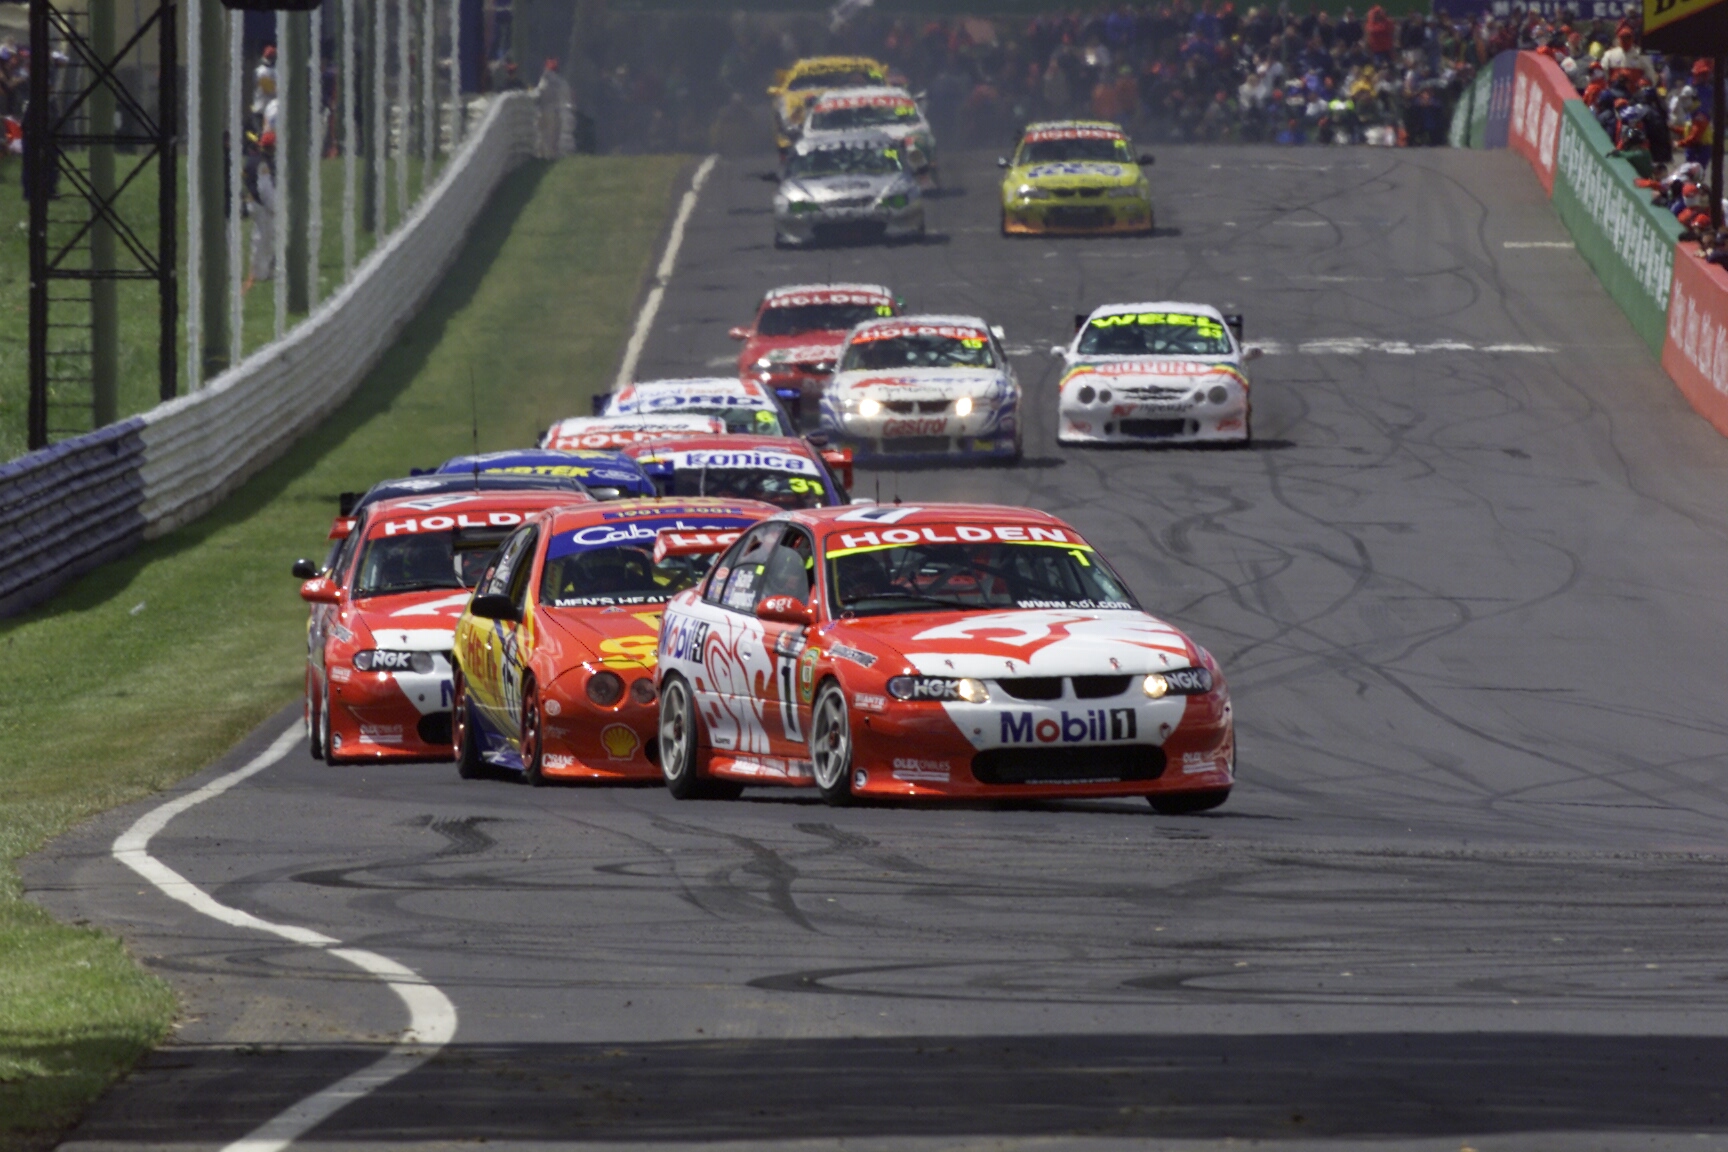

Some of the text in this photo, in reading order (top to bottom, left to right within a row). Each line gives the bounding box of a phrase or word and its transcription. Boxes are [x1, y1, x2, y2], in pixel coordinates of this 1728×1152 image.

[771, 294, 889, 308] HOLDEN
[1091, 313, 1223, 329] WEEL
[861, 326, 978, 339] HOLDEN
[883, 417, 948, 437] Castrol
[686, 452, 804, 470] Konica
[788, 477, 825, 495] 31
[385, 512, 538, 535] HOLD
[840, 526, 1068, 548] HOLDEN
[1068, 549, 1091, 567] 1
[555, 597, 615, 607] MEN'S
[372, 651, 411, 668] NGK
[1166, 673, 1202, 690] NGK
[1000, 708, 1107, 743] Mobil
